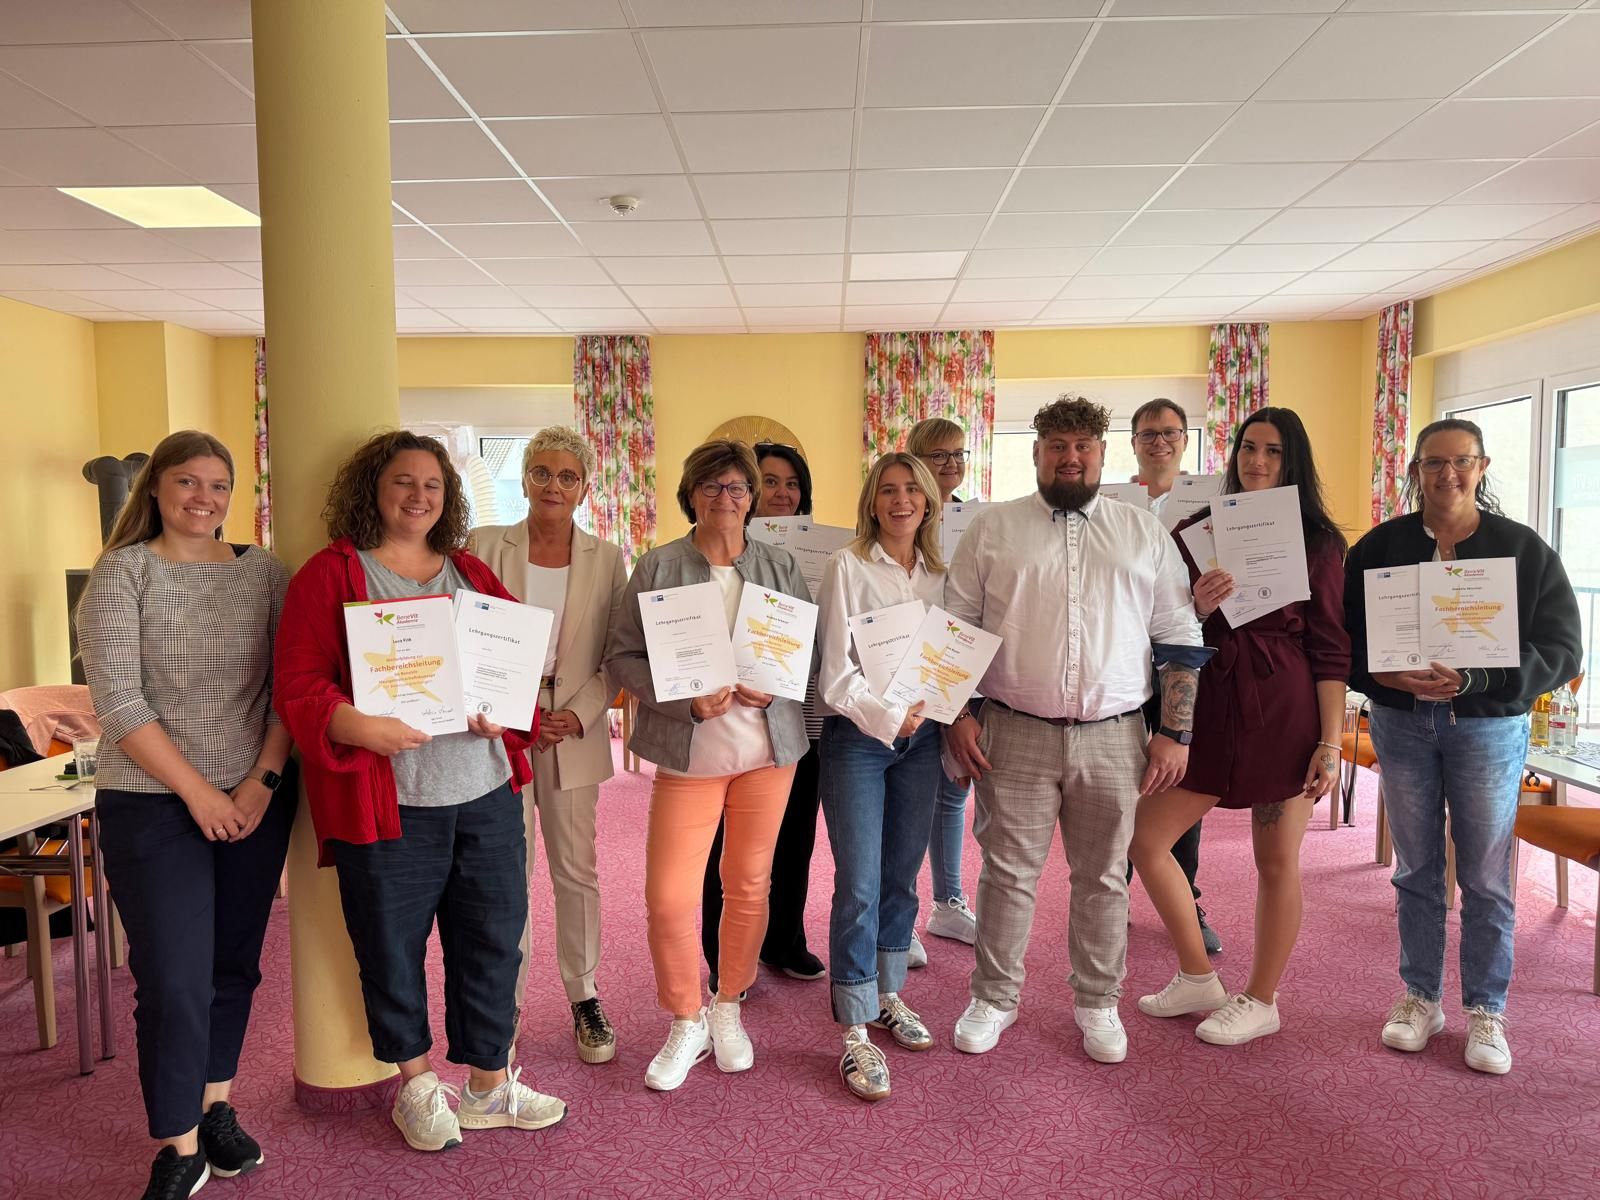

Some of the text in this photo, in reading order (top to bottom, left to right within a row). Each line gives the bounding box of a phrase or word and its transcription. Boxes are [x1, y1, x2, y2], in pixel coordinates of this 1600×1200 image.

[1226, 521, 1275, 532] Lehrgangszertifikat
[794, 546, 833, 556] Lehrgangszertifikat
[1434, 604, 1502, 612] Fachbereichsleitung
[396, 613, 419, 621] BeneVit
[655, 615, 701, 626] Lehrgangszertifikat
[468, 627, 521, 645] Lehrgangszertifikat
[747, 628, 801, 650] Fachbereichsleitung
[868, 633, 911, 649] Lehrgangszertifikat
[370, 658, 441, 674] Fachbereichsleitung
[919, 652, 969, 681] Fachbereichsleitung
